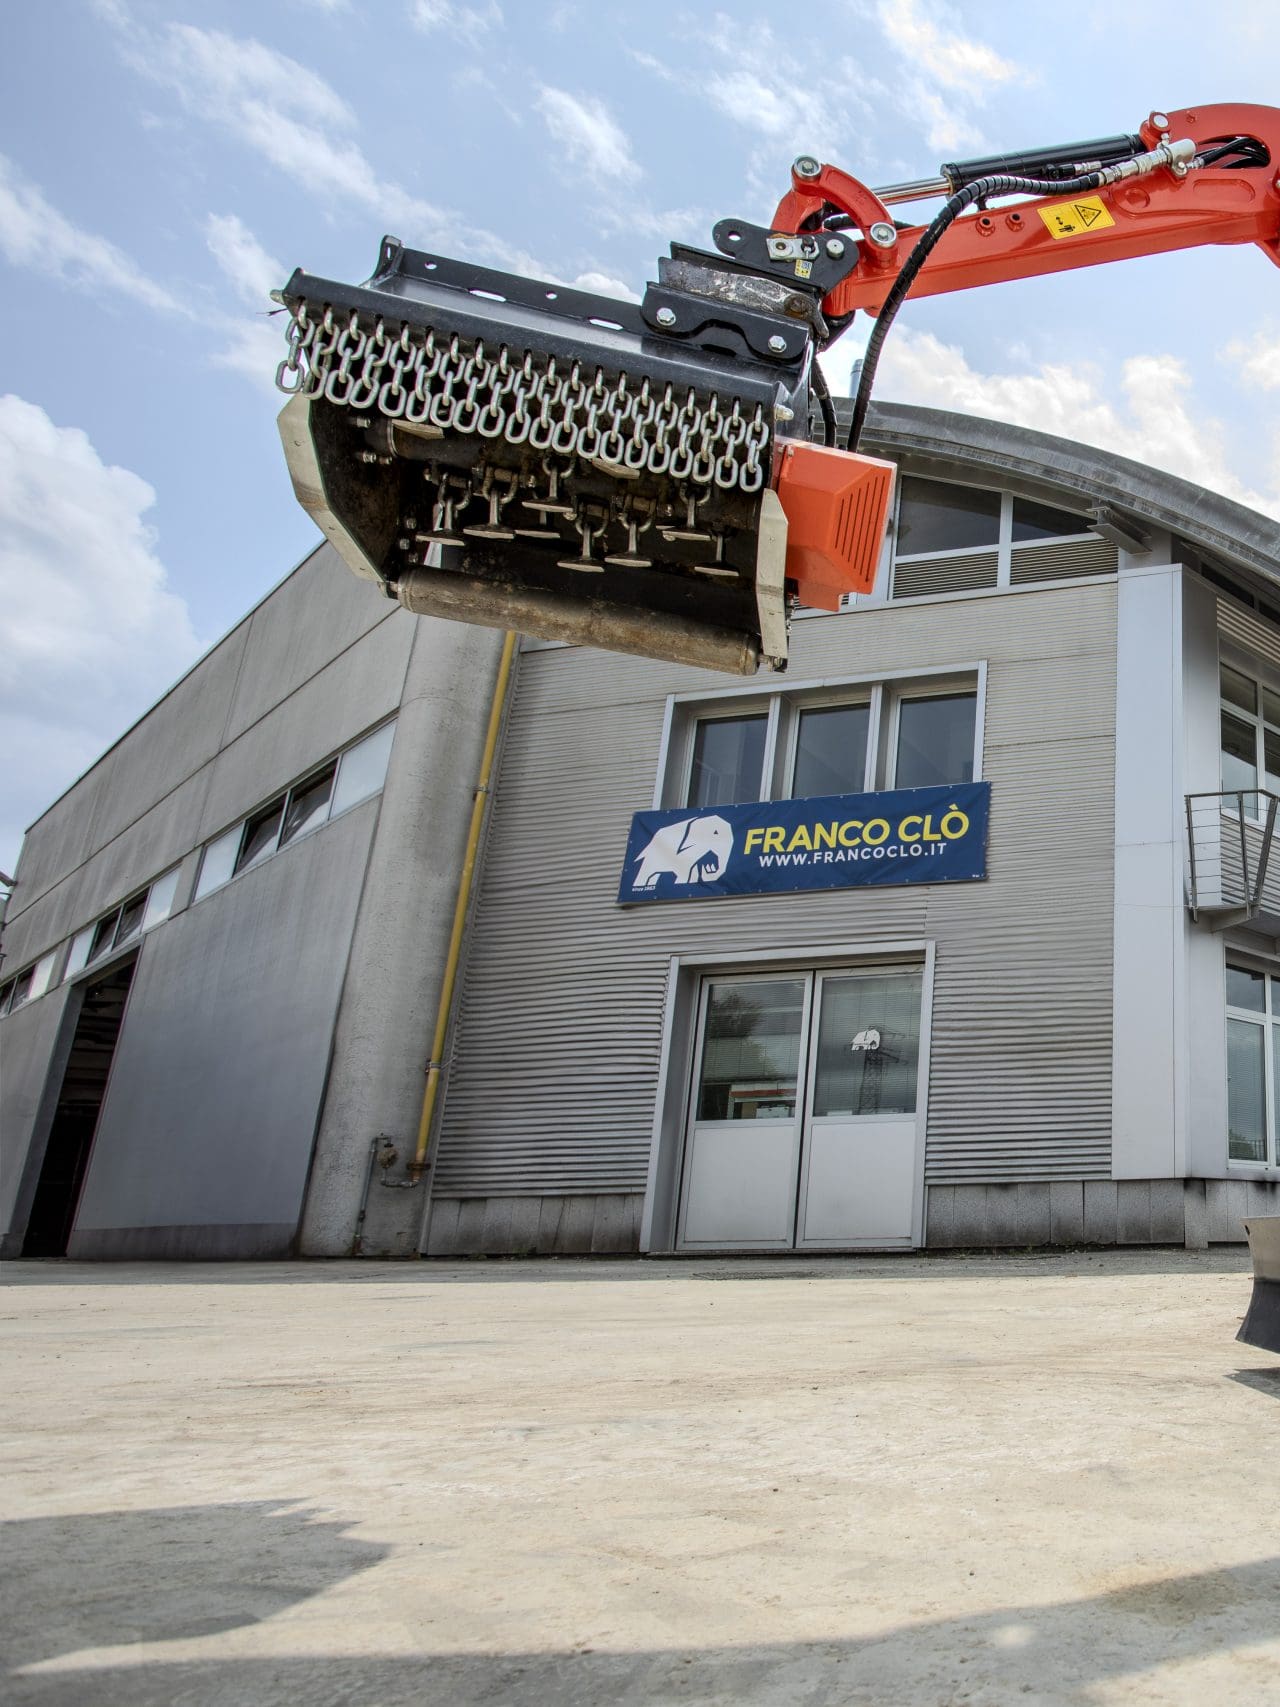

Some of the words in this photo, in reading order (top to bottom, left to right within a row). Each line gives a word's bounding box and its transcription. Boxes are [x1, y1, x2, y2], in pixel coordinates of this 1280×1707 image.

[744, 818, 890, 855] FRANCO
[898, 803, 969, 842] CLÒ
[759, 842, 947, 868] WWW.FRANCOCLO.IT
